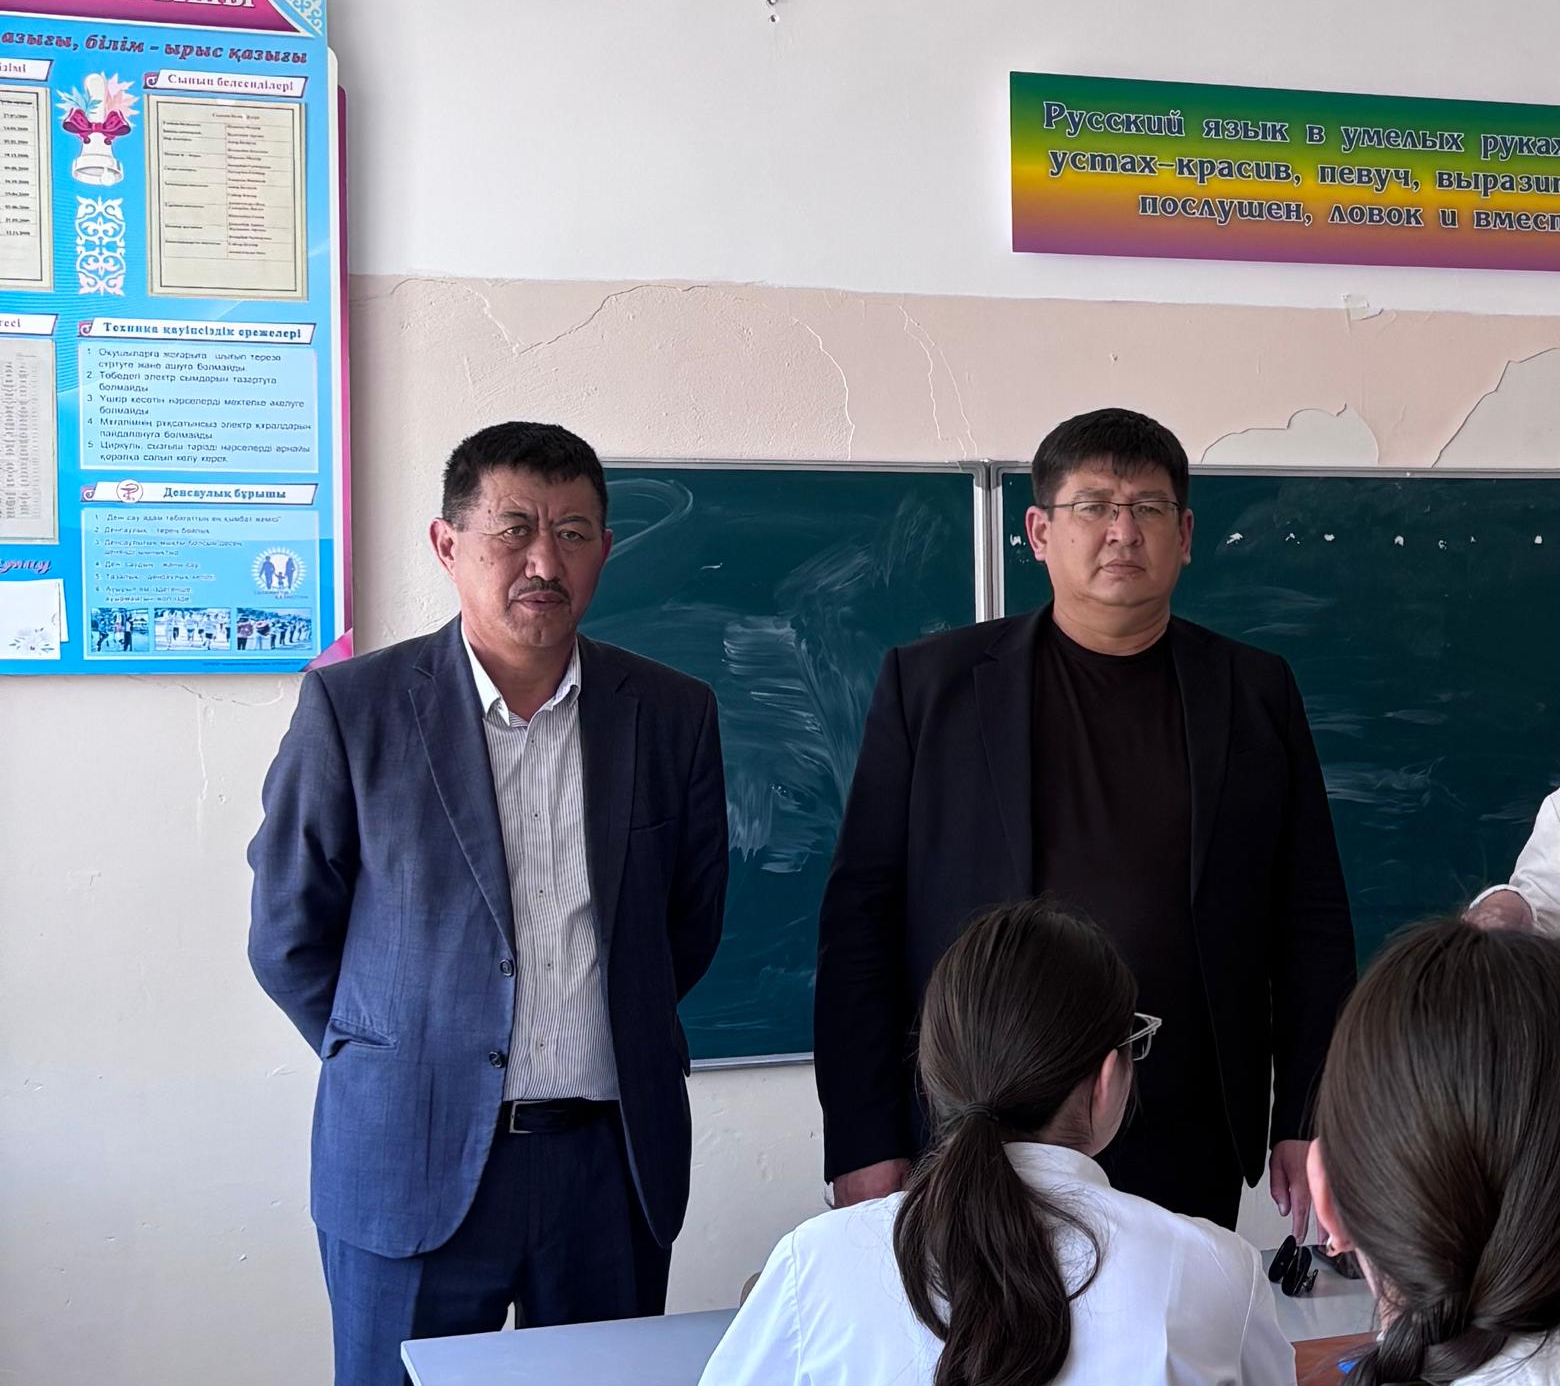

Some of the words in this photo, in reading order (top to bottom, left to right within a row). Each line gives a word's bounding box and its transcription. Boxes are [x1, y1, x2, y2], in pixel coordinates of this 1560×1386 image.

[85, 34, 144, 54] білім
[165, 43, 223, 60] ырыс
[229, 47, 307, 63] қазығы
[1043, 101, 1185, 138] Русский
[1203, 117, 1289, 143] язык
[1306, 124, 1326, 144] в
[1341, 124, 1464, 152] умелых
[1318, 163, 1420, 193] певуч,
[1138, 194, 1313, 227] послушен,
[1328, 203, 1424, 228] ловок
[1439, 208, 1457, 229] и
[103, 322, 159, 334] Техника
[238, 328, 302, 340] ережелері
[163, 487, 232, 500] Денсаулық
[234, 488, 287, 500] бұрышы
